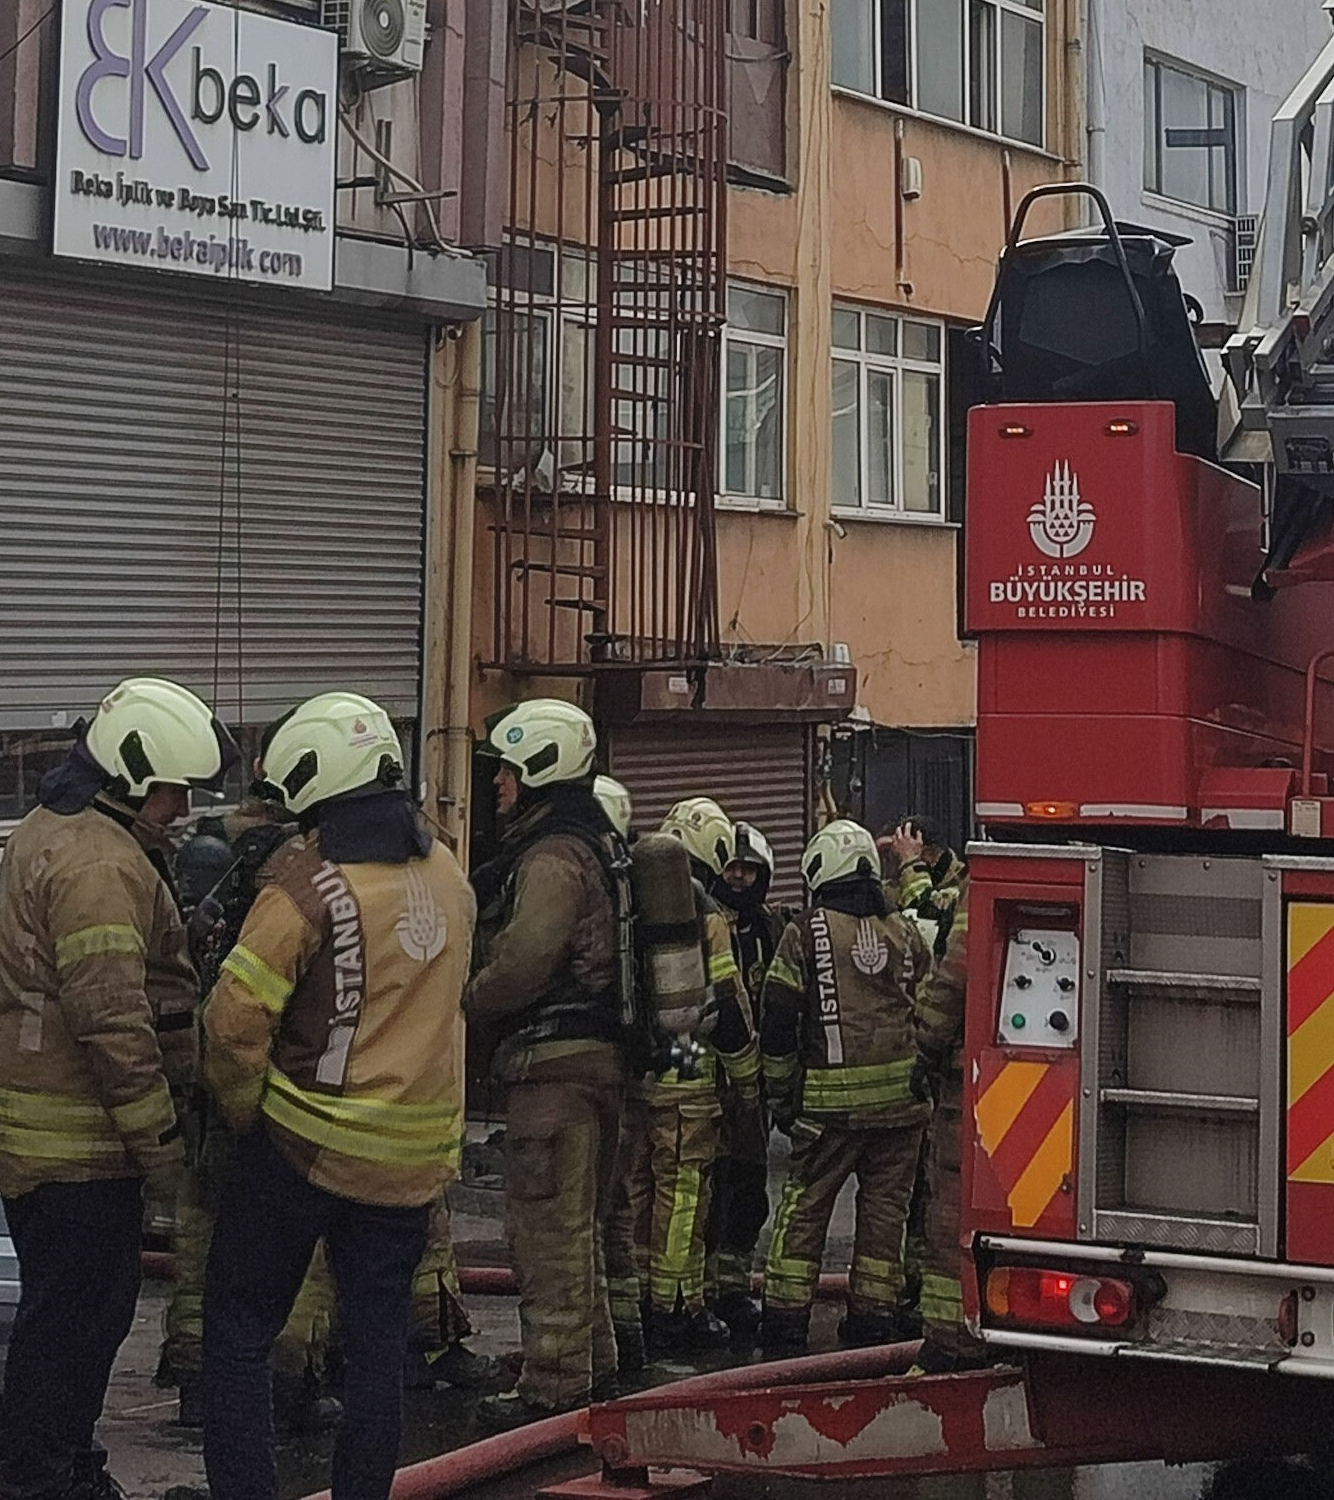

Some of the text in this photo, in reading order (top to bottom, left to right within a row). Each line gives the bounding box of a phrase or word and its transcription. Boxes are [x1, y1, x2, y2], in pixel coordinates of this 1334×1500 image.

[191, 46, 327, 143] beka
[70, 170, 112, 198] Beka
[116, 171, 153, 207] İplik
[155, 188, 175, 208] ve
[178, 187, 215, 217] Boya
[1018, 564, 1114, 576] İSTANBUL
[990, 575, 1146, 607] BÜYÜKŞEHİR
[1018, 604, 1114, 617] BELEDİYESİ
